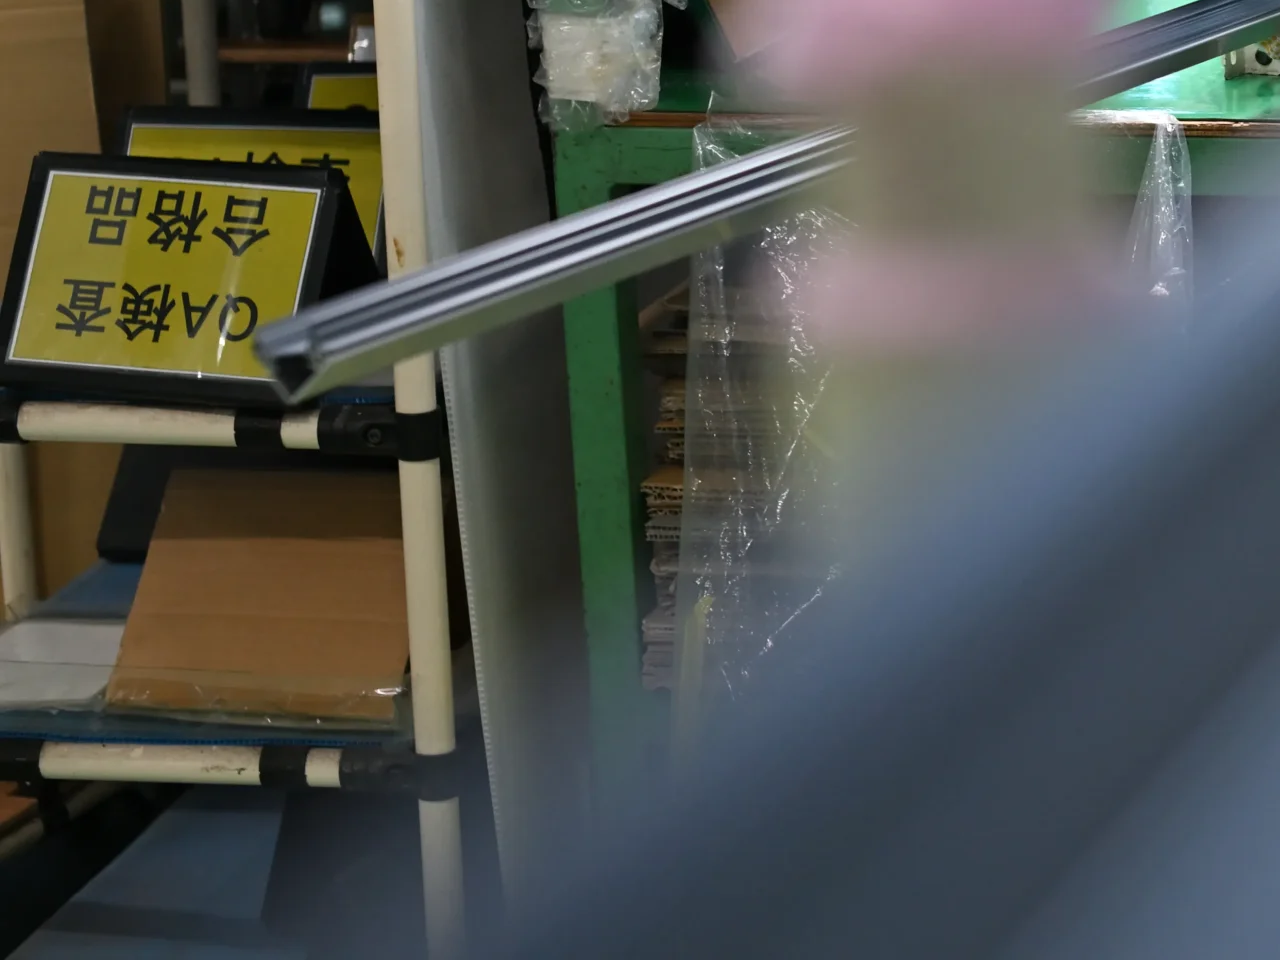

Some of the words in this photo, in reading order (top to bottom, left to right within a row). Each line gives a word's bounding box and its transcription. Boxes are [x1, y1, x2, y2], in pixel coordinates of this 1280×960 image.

[85, 185, 270, 257] 合格品
[55, 278, 258, 343] QA検査
